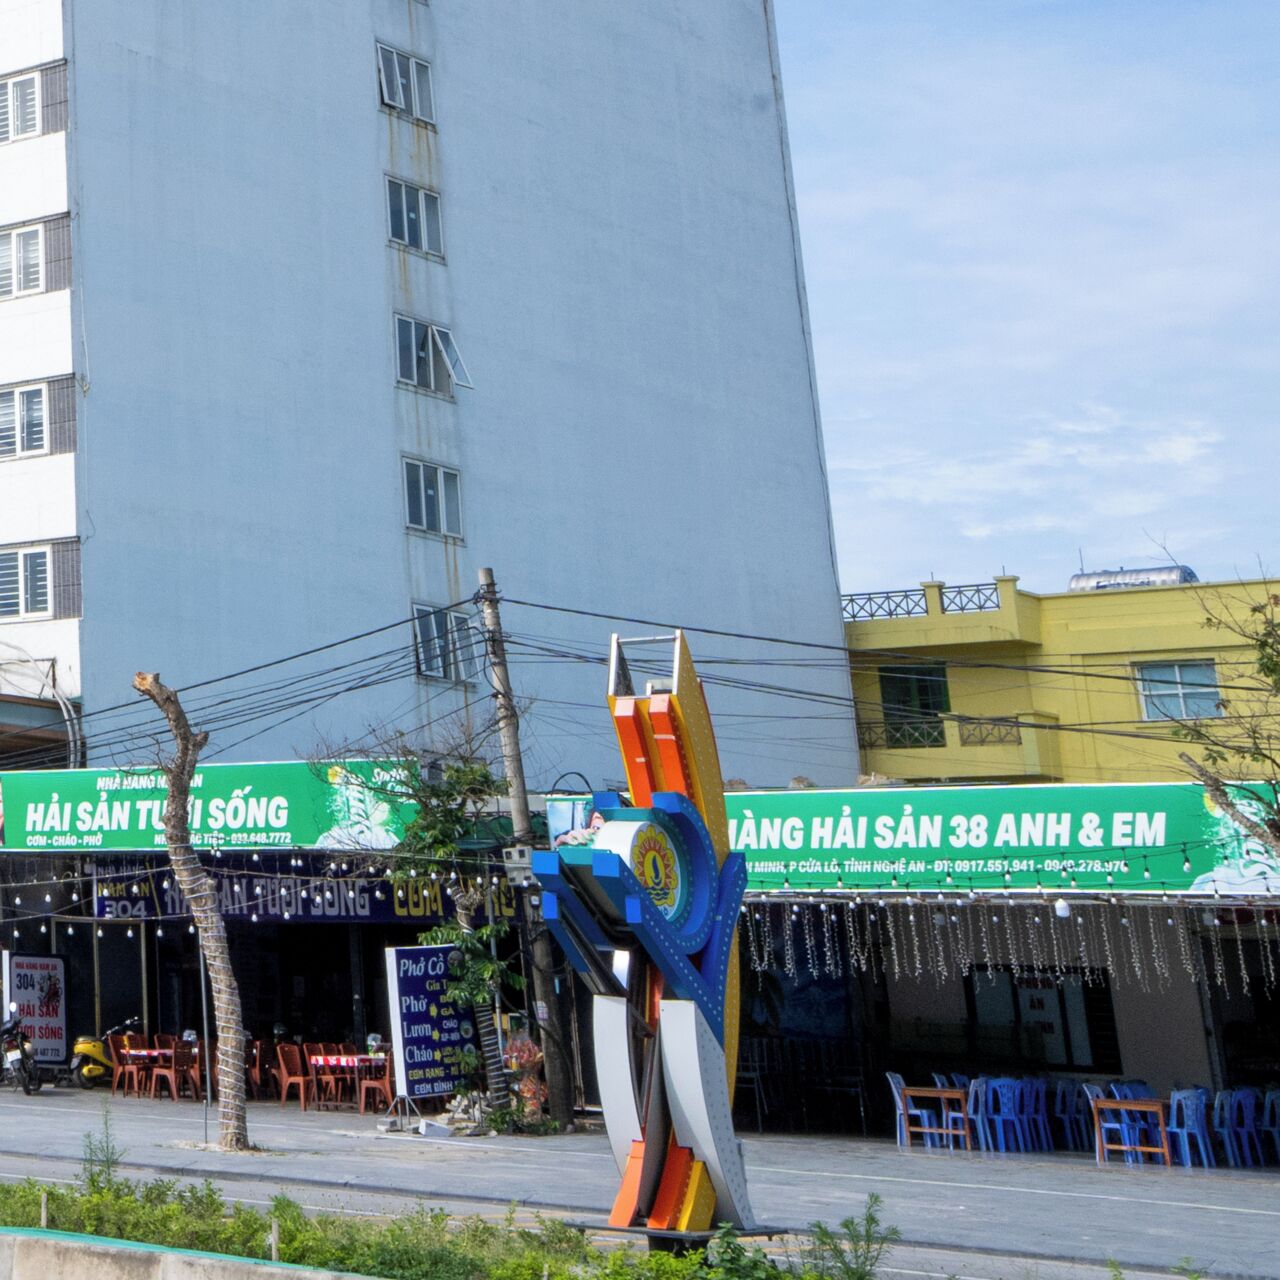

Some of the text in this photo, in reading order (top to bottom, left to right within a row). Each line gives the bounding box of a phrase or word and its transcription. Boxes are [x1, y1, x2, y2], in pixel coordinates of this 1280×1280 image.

[97, 773, 121, 790] NHÀ
[25, 792, 71, 831] HẢI
[76, 792, 131, 831] SẢN
[207, 786, 288, 830] SỐNG
[810, 805, 867, 849] HẢI
[873, 804, 942, 849] SẢN
[948, 814, 988, 848] 38
[993, 812, 1072, 848] ANH
[1078, 811, 1105, 848] &
[1111, 812, 1166, 847] EM
[798, 858, 822, 873] CỬA
[843, 857, 872, 873] TỈNH
[873, 858, 906, 875] NGHỆ
[907, 861, 925, 872] AN
[954, 859, 1034, 872] 0917.551.941
[104, 899, 147, 919] 304
[400, 956, 425, 977] Phở
[16, 972, 35, 991] 304
[426, 980, 440, 991] Gia
[401, 995, 427, 1013] Phở
[38, 1023, 63, 1040] SỐNG
[403, 1021, 432, 1038] Lươn
[405, 1044, 433, 1063] Cháo
